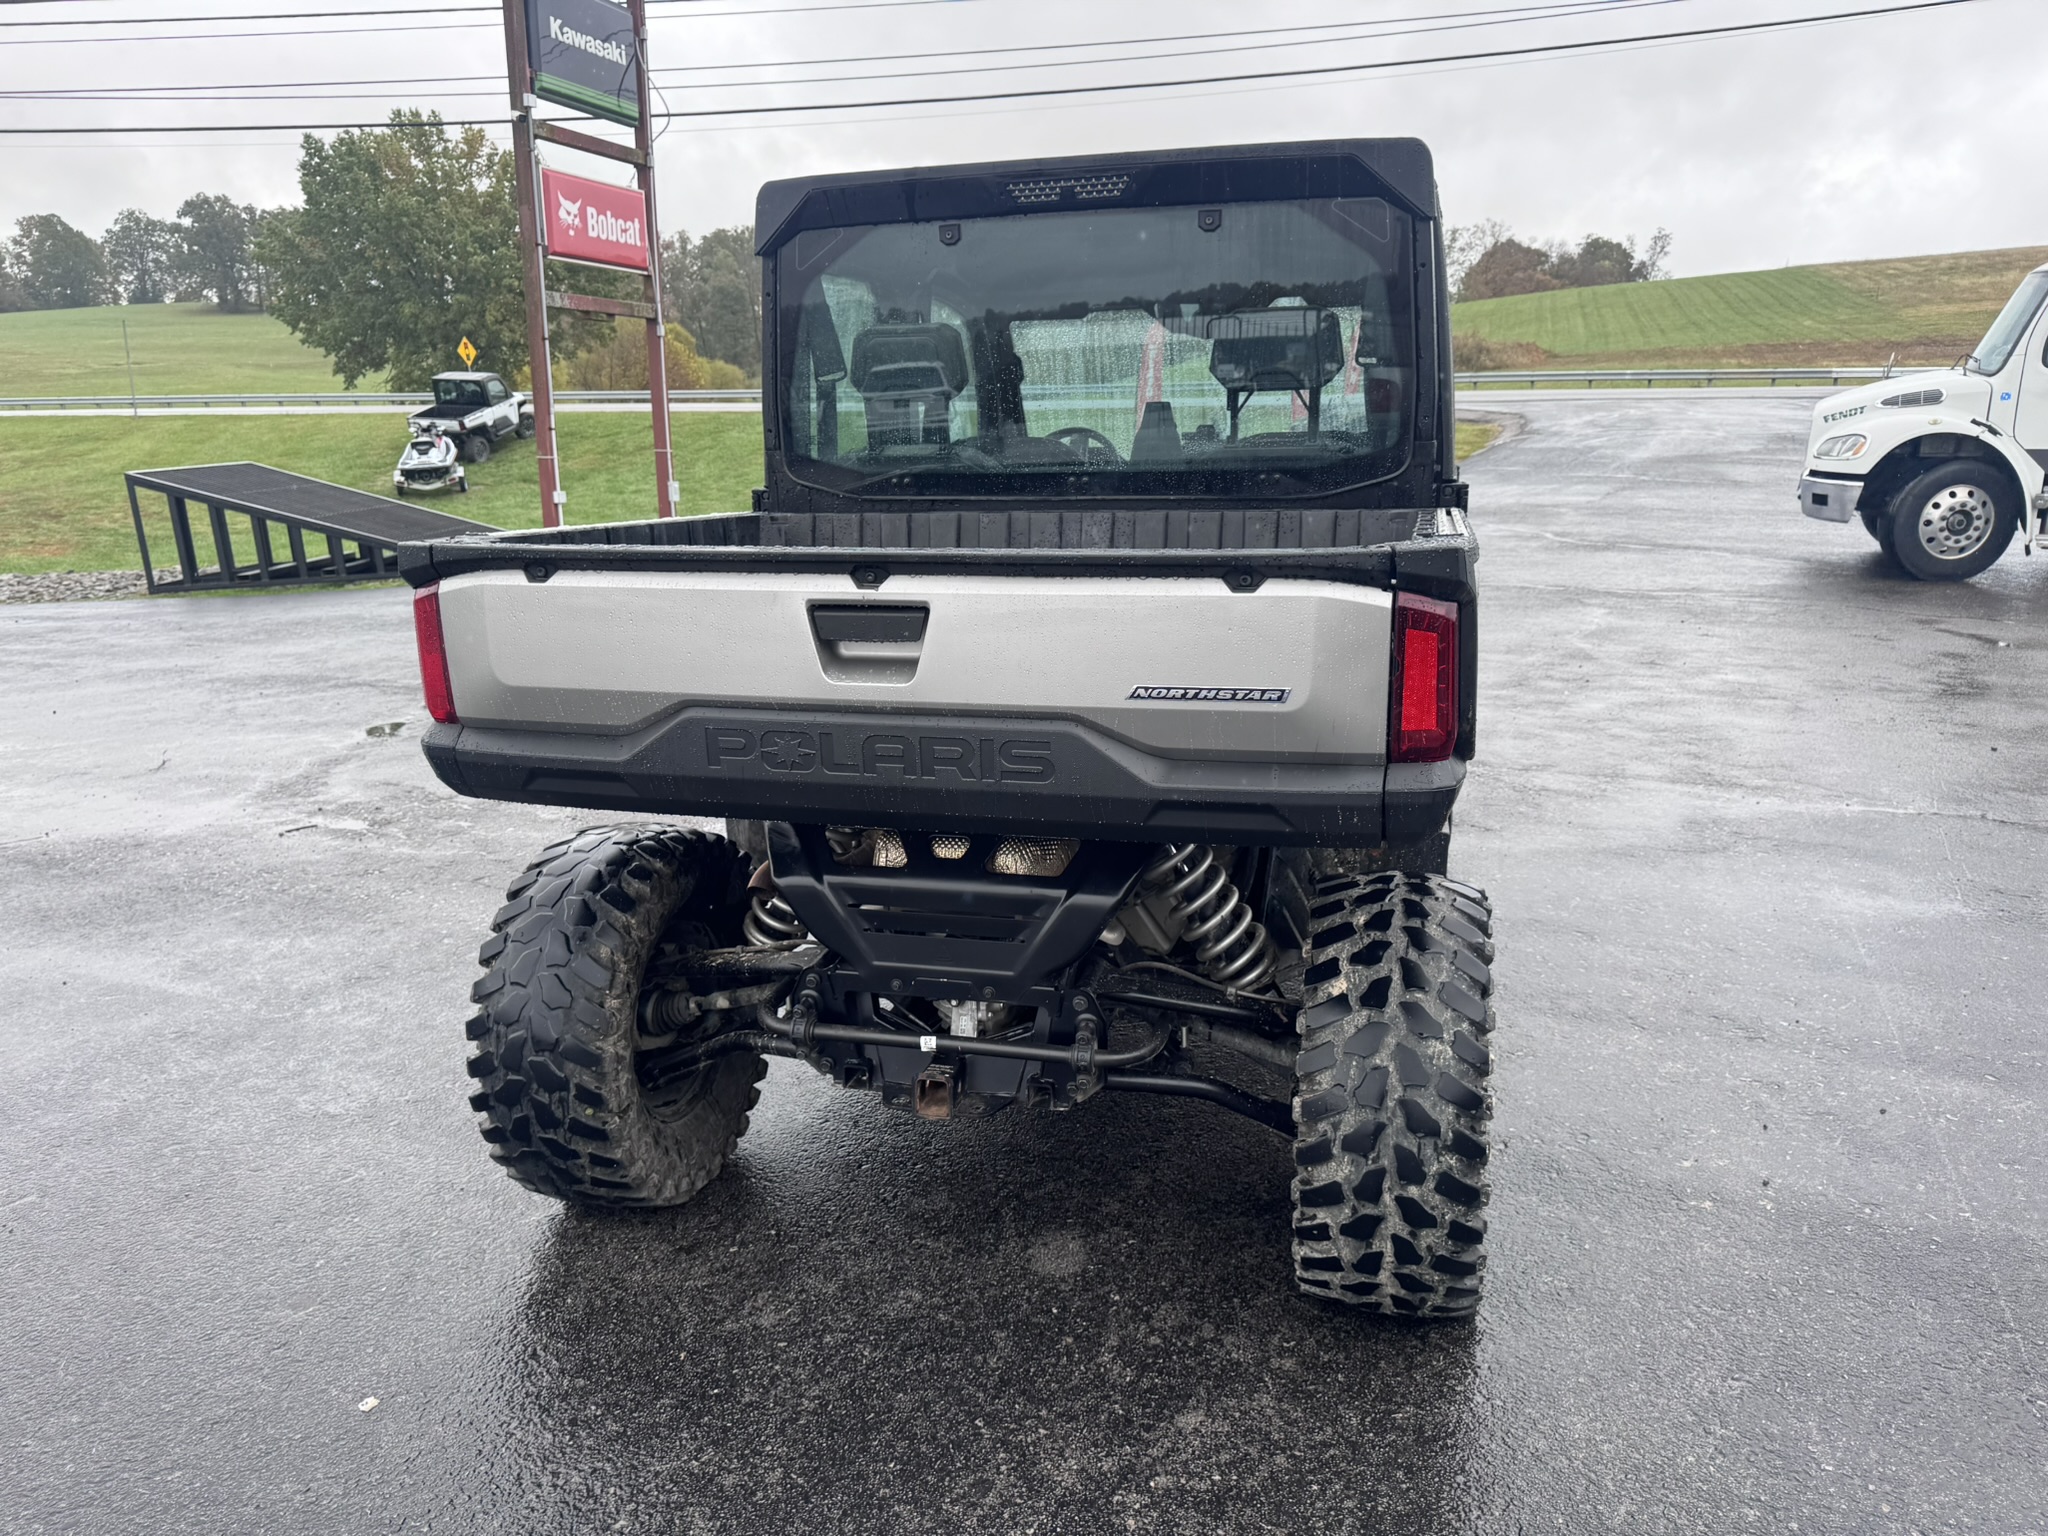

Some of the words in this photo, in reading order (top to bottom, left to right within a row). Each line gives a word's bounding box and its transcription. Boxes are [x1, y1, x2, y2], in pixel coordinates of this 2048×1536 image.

[549, 15, 627, 66] Kawasaki
[586, 206, 642, 247] Bobcat
[1823, 404, 1868, 423] FENDT
[1133, 687, 1283, 701] NORTHSTAR
[704, 726, 1056, 784] POLARIS
